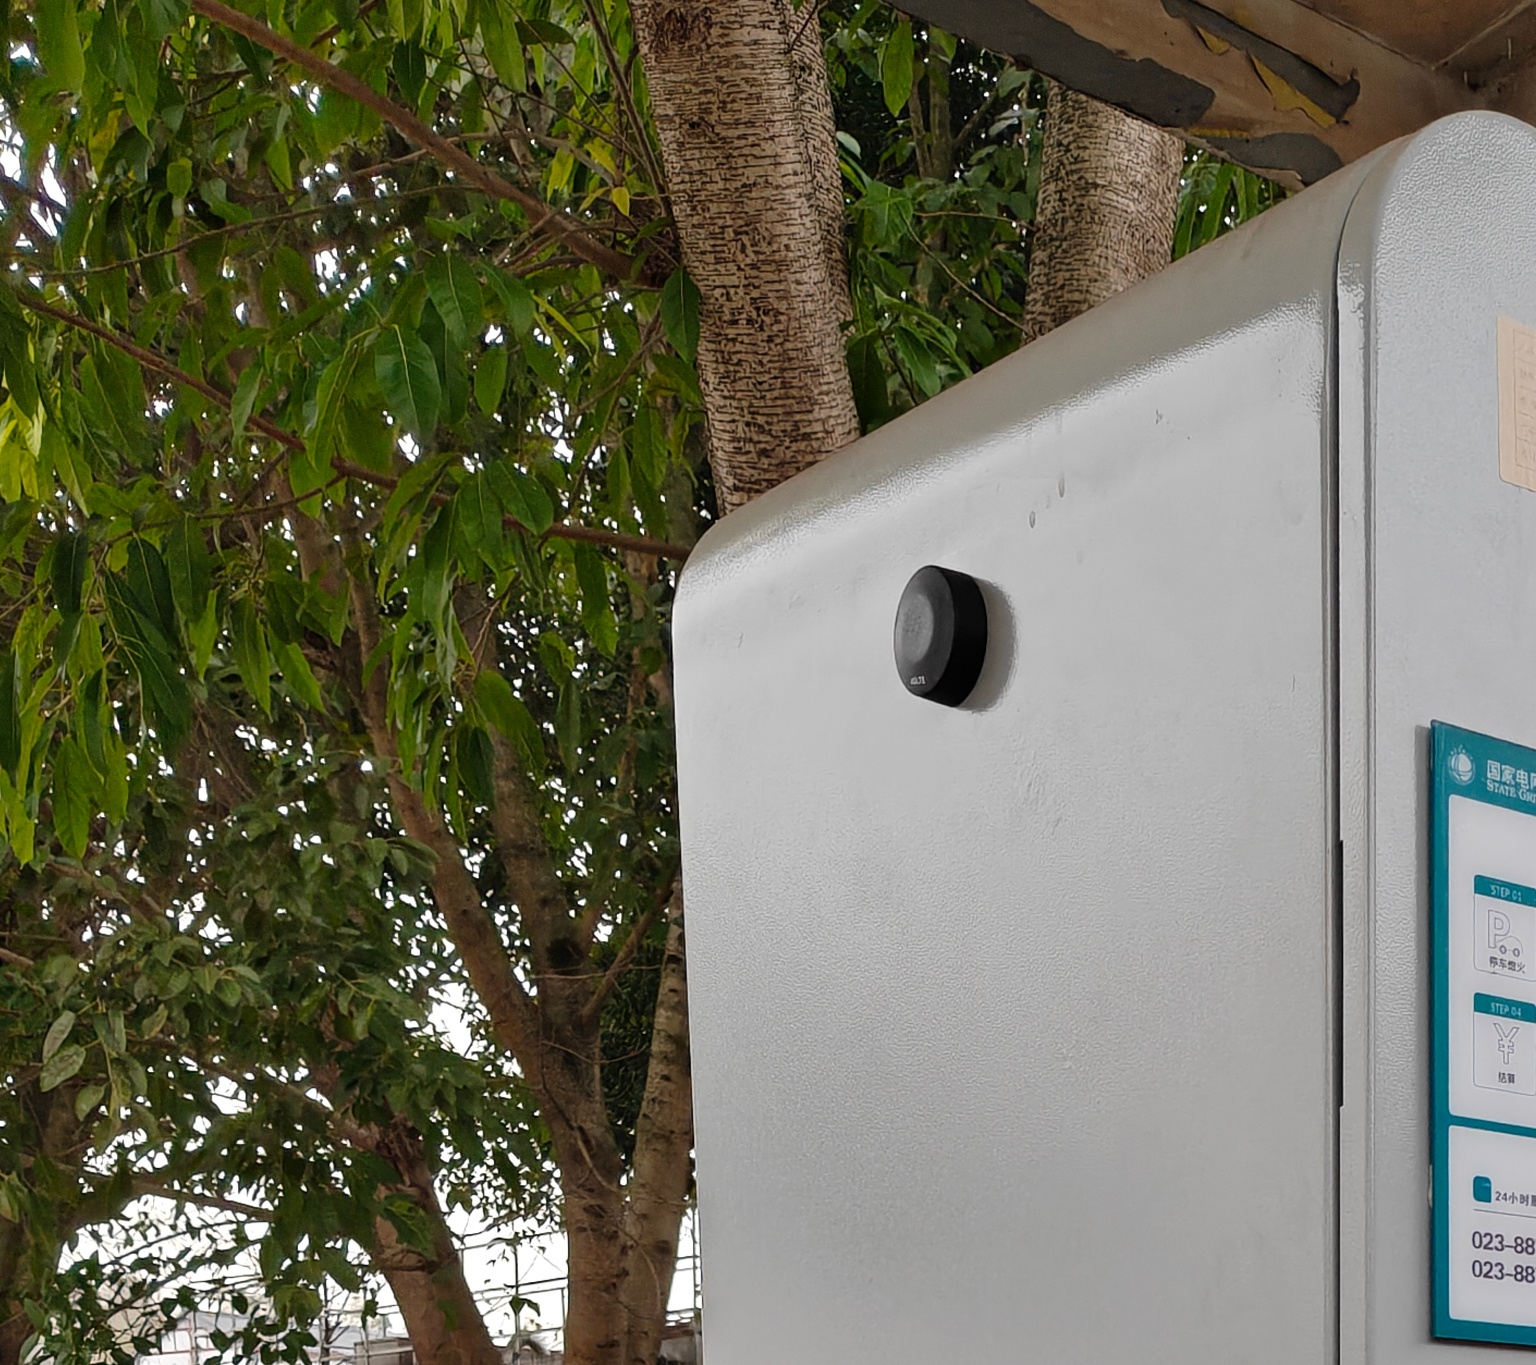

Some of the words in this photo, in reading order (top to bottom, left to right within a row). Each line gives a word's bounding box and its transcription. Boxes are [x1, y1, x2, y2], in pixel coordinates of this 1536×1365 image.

[1490, 885, 1510, 898] STEP
[1490, 1001, 1510, 1015] STEP
[1511, 1004, 1523, 1018] 04
